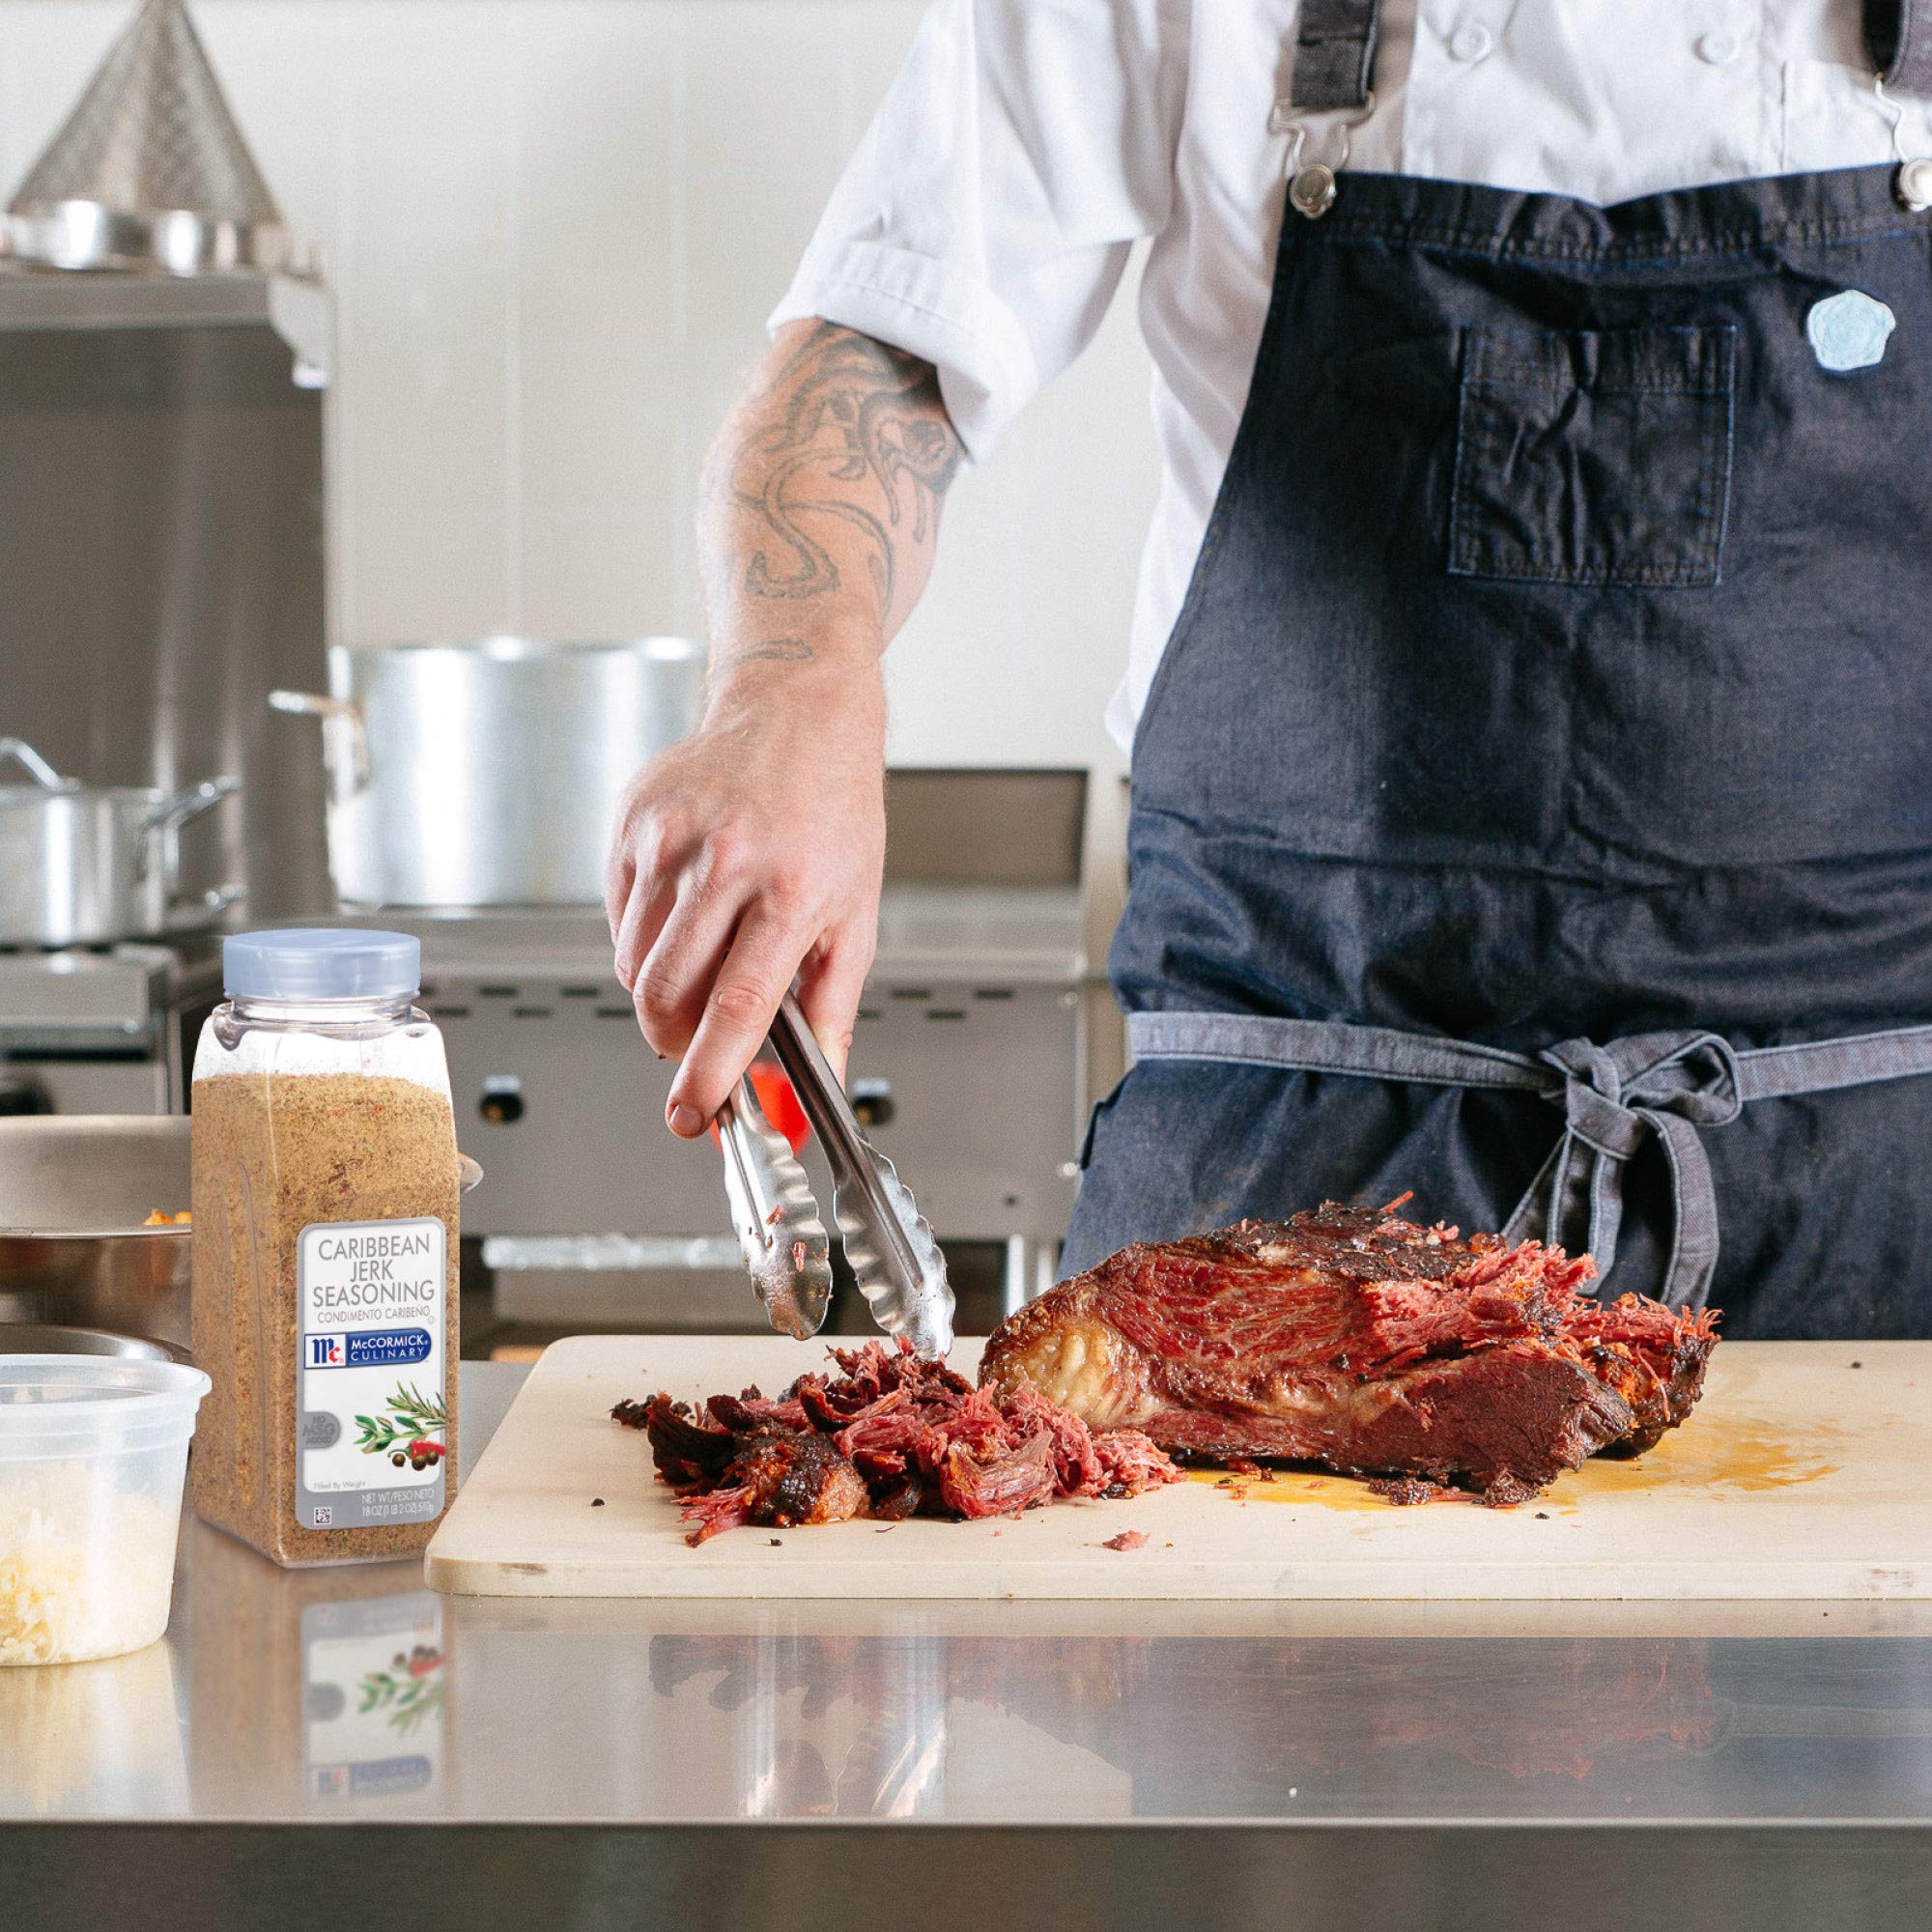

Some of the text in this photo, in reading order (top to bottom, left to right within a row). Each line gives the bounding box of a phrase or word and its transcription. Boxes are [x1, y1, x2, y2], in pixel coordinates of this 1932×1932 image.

[319, 1234, 429, 1260] CARIBBEAN
[350, 1260, 394, 1282] JERK
[313, 1280, 435, 1307] SEASONING
[317, 1309, 383, 1323] CONDIMENTO
[351, 1348, 424, 1361] CULINARY
[302, 1422, 335, 1436] MSG
[361, 1492, 376, 1504] NET
[414, 1488, 435, 1500] NETO
[361, 1506, 371, 1517] 18
[371, 1505, 383, 1516] OZ
